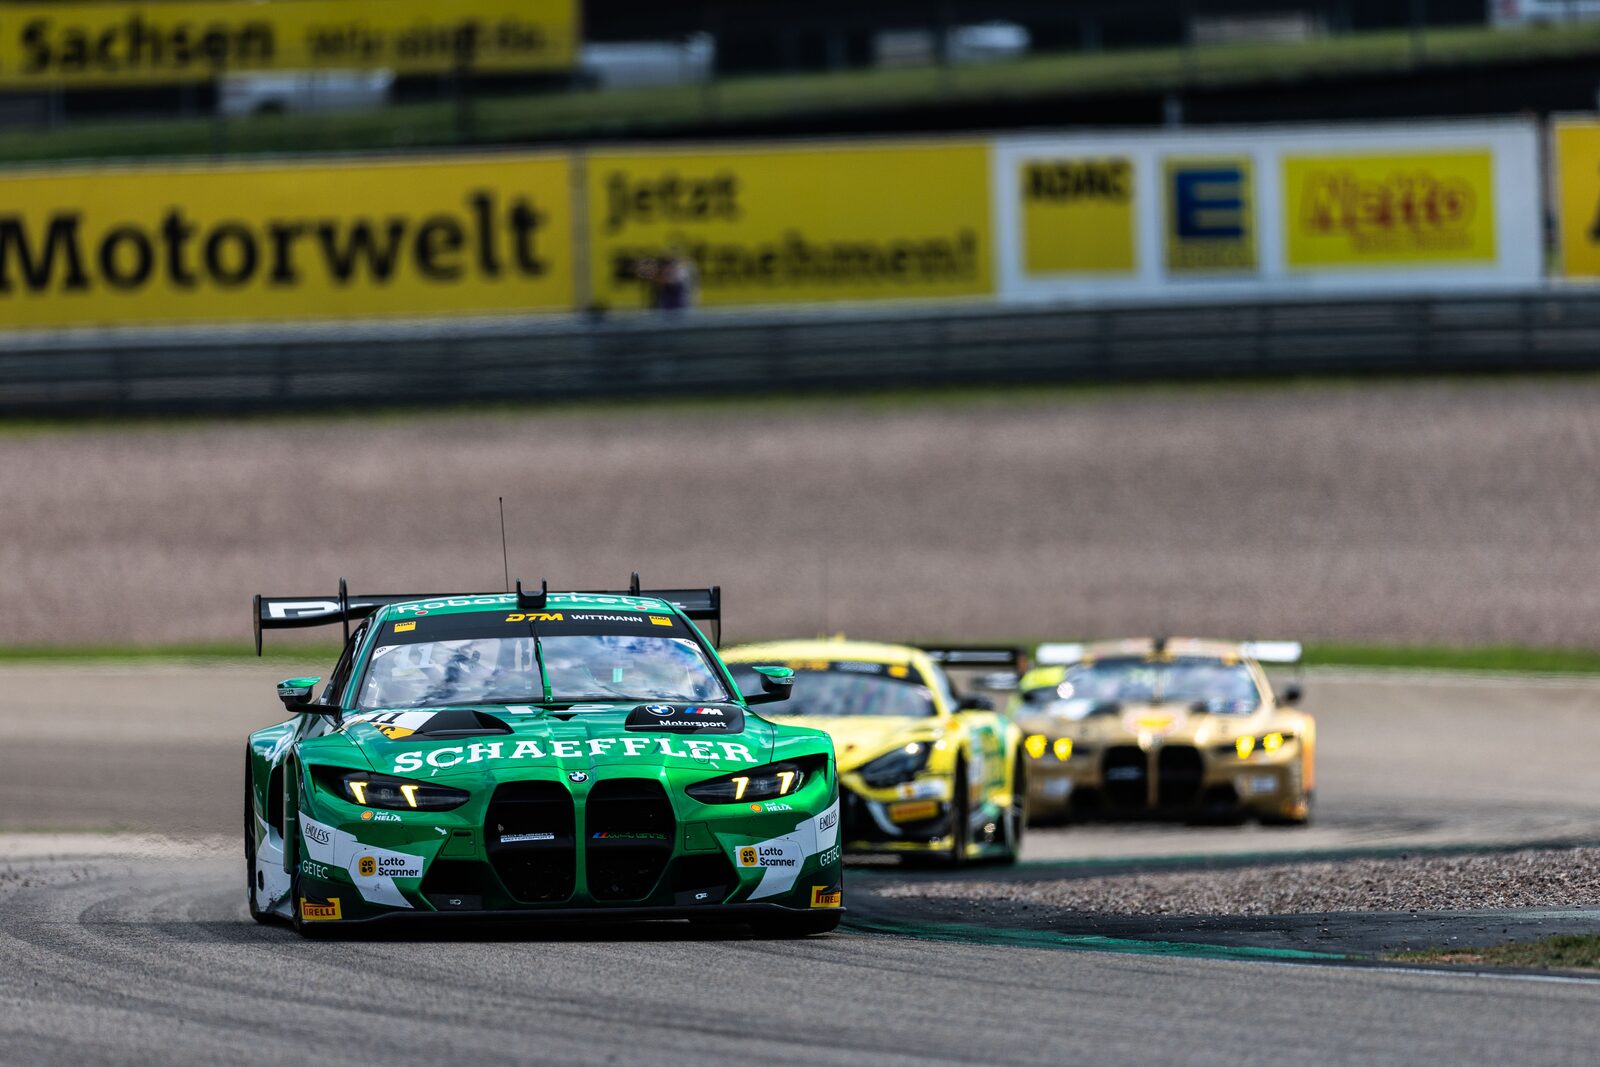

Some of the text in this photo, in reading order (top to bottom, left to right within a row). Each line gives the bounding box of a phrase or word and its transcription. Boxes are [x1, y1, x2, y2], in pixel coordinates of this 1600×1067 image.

[20, 16, 275, 72] Sachsen
[1175, 170, 1244, 239] E
[0, 190, 548, 294] Motorwelt
[611, 232, 978, 288] mtnehmen!
[397, 595, 661, 614] RoboMrkets
[505, 613, 643, 622] DTM WITTMANN
[367, 712, 405, 724] 11
[659, 720, 727, 728] Motorsport
[394, 737, 758, 773] SCHAEFFLER
[767, 804, 793, 812] HELIX
[305, 822, 330, 842] ENDLESS
[759, 847, 783, 856] Lotto
[820, 845, 840, 866] GETEC
[302, 860, 329, 879] GETEC
[378, 857, 405, 866] Lotto
[760, 858, 796, 867] Scanner
[378, 867, 419, 876] Scanner
[303, 902, 336, 916] PIRELLI
